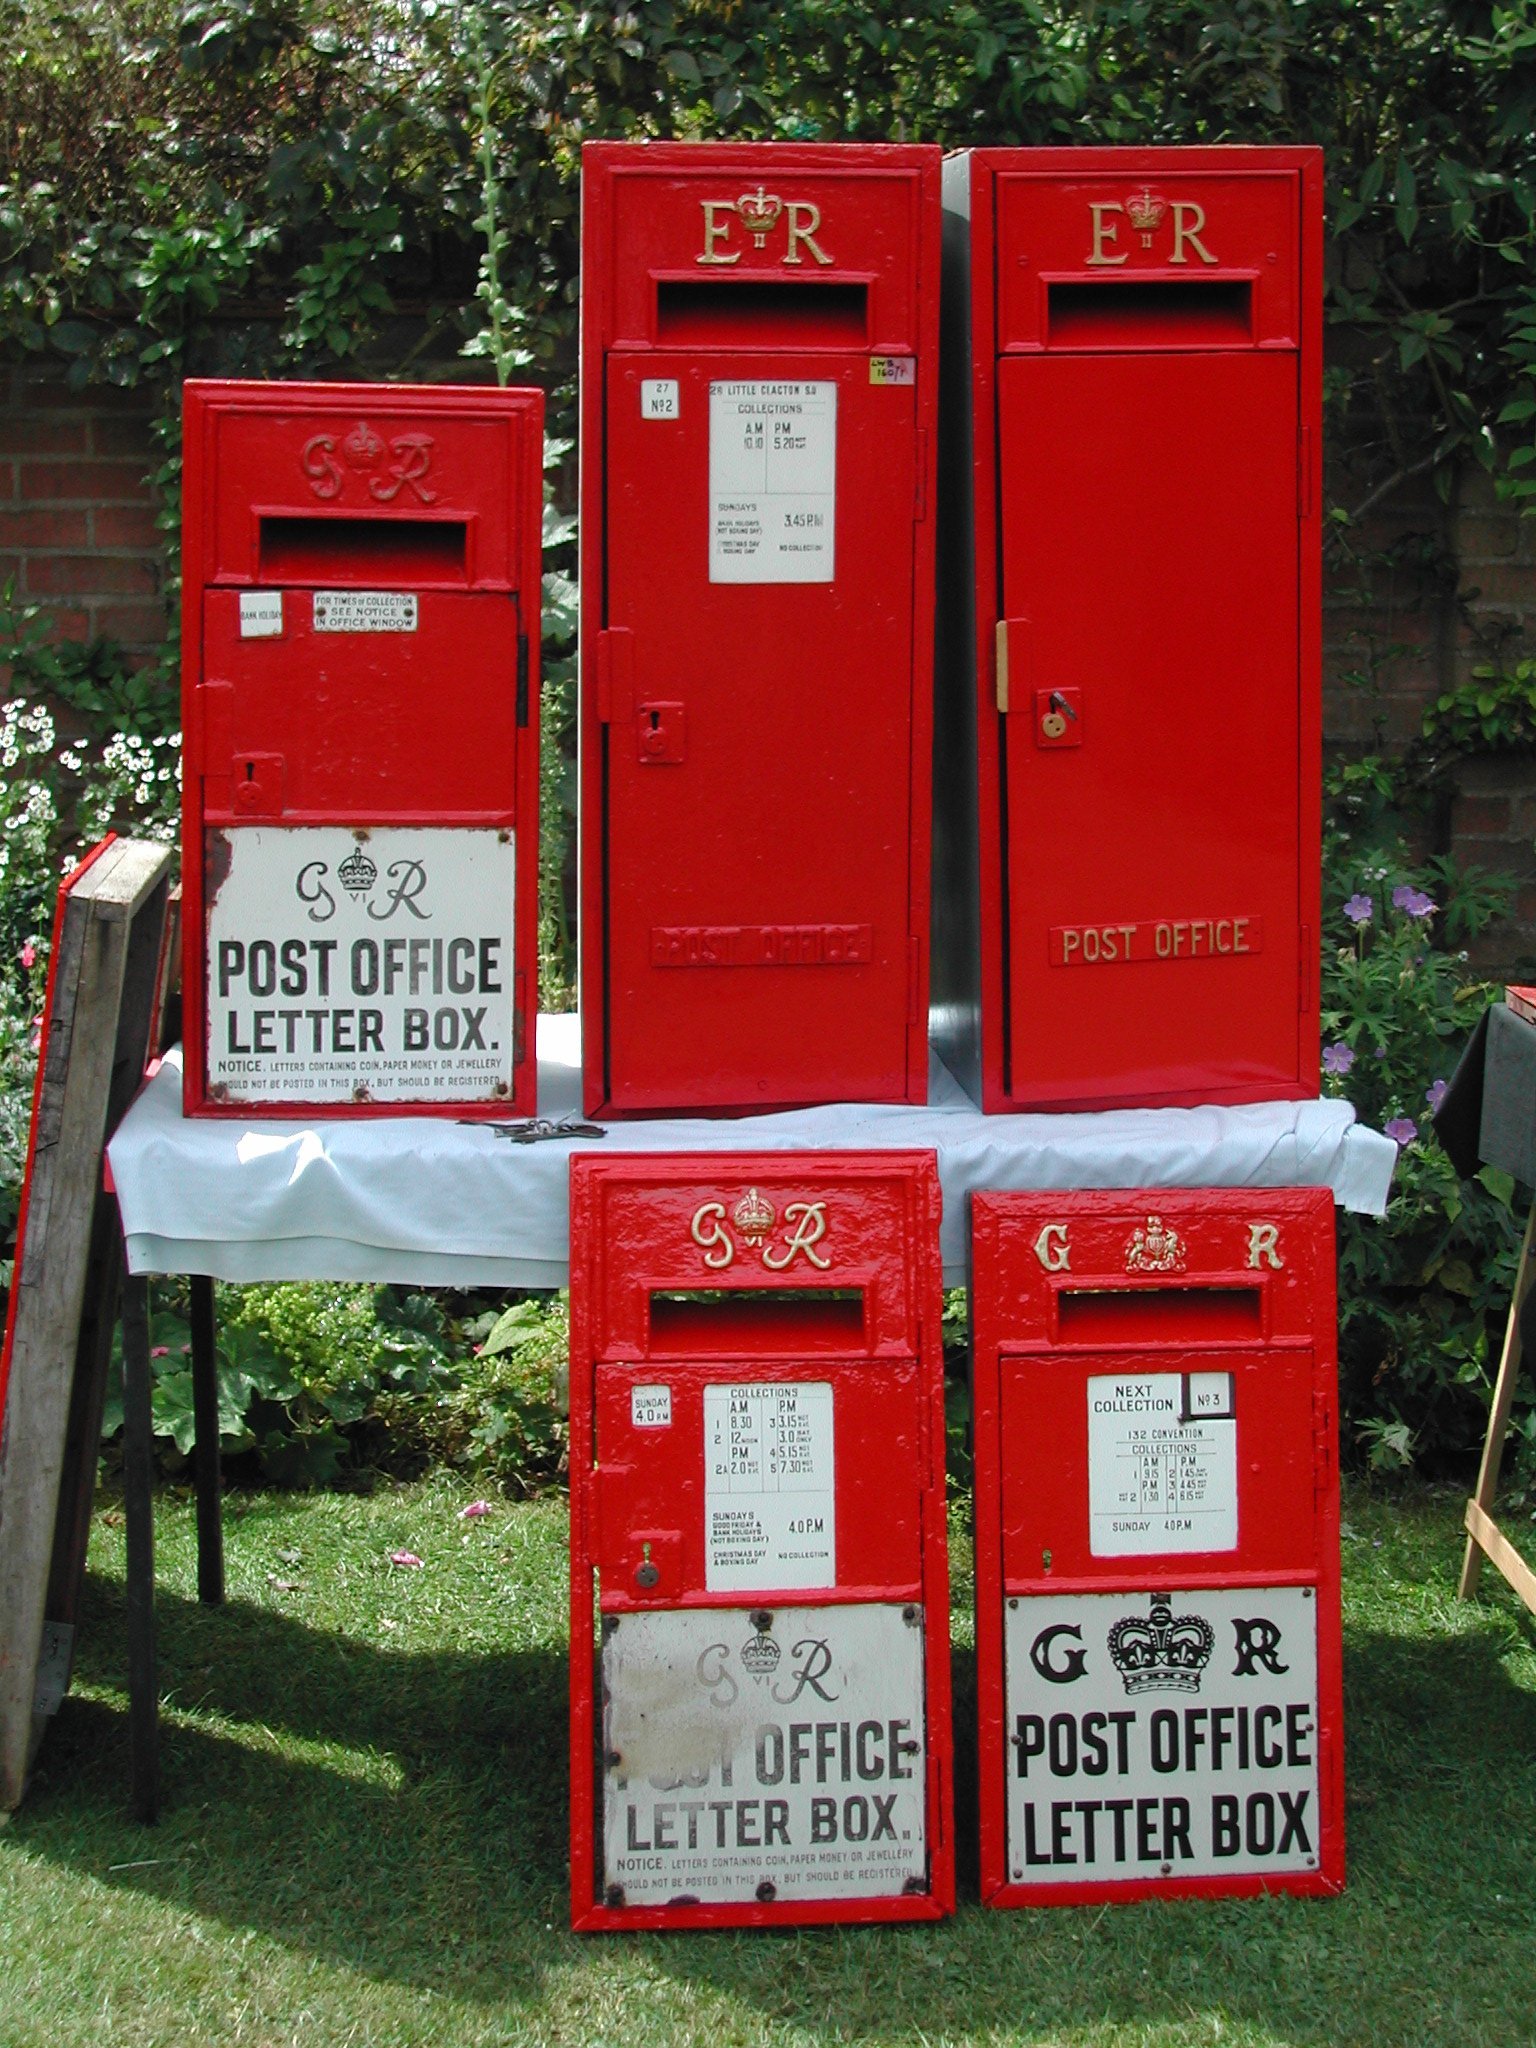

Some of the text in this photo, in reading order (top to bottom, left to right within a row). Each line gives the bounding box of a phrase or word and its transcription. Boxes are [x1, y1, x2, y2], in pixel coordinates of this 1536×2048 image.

[696, 201, 741, 263] E
[782, 202, 834, 264] R
[1086, 203, 1129, 264] E
[1169, 203, 1219, 263] R
[656, 384, 669, 393] 27
[728, 386, 756, 396] LITTLE
[738, 404, 802, 414] COLLECTIONS
[369, 432, 437, 503] R
[316, 597, 332, 606] FOR
[334, 597, 357, 606] TIMES
[366, 597, 413, 606] COLLECTION
[331, 608, 397, 616] SEE NOTICE
[316, 619, 413, 627] IN OFFICE WINDOW
[296, 859, 433, 922] G VI R
[1064, 918, 1250, 963] POST OFFICE
[218, 937, 502, 998] POST OFFICE
[227, 1007, 499, 1054] LETTER BOX.
[270, 1062, 305, 1072] LETTERS
[309, 1062, 356, 1071] CONTAINING
[410, 1060, 438, 1070] MONEY
[441, 1060, 452, 1070] OR
[456, 1058, 501, 1069] JEWELLERY
[252, 1080, 267, 1089] NOT
[270, 1080, 280, 1089] BE
[284, 1079, 314, 1089] POSTED
[318, 1079, 328, 1088] IN
[330, 1079, 349, 1088] THIS
[377, 1078, 394, 1088] BUT
[398, 1078, 430, 1087] SHOULD
[434, 1077, 444, 1086] BE
[691, 1202, 734, 1268] G
[762, 1202, 831, 1269] R
[1034, 1223, 1284, 1271] G R
[731, 1388, 798, 1399] COLLECTIONS
[1116, 1385, 1153, 1398] NEXT
[636, 1398, 669, 1409] SUNDAY
[1213, 1394, 1220, 1405] 3
[1094, 1399, 1173, 1413] COLLECTION
[731, 1416, 752, 1429] 8.30
[770, 1418, 776, 1428] 3
[779, 1415, 797, 1428] 3.15
[714, 1434, 721, 1444] 2
[1128, 1429, 1203, 1440] 132 CONVENTION
[770, 1448, 776, 1458] 4
[1132, 1444, 1197, 1455] COLLECTIONS
[731, 1462, 746, 1474] 2.0
[770, 1464, 777, 1473] 5
[1169, 1469, 1176, 1479] 2
[1169, 1481, 1176, 1490] 3
[1130, 1493, 1137, 1502] 2
[1168, 1492, 1175, 1500] 4
[713, 1512, 754, 1521] SUNDAYS
[1112, 1522, 1151, 1532] SUNDAY
[1030, 1618, 1290, 1683] G R
[753, 1675, 770, 1687] VI
[771, 1638, 840, 1704] R
[1016, 1704, 1312, 1778] POST OFFICE
[755, 1719, 912, 1786] OFFICE
[626, 1794, 911, 1851] LETTER BOX.
[1024, 1790, 1312, 1865] LETTER BOX
[672, 1859, 708, 1869] LETTERS
[712, 1856, 761, 1868] CONTAINING
[819, 1852, 847, 1863] MONEY
[851, 1852, 862, 1862] OR
[867, 1849, 913, 1860] JEWELLERY
[652, 1878, 668, 1888] NOT
[672, 1878, 683, 1887] BE
[686, 1876, 717, 1887] POSTED
[722, 1876, 732, 1886] IN
[736, 1875, 755, 1885] THIS
[784, 1873, 801, 1883] BUT
[806, 1872, 839, 1882] SHOULD
[844, 1870, 854, 1880] BE
